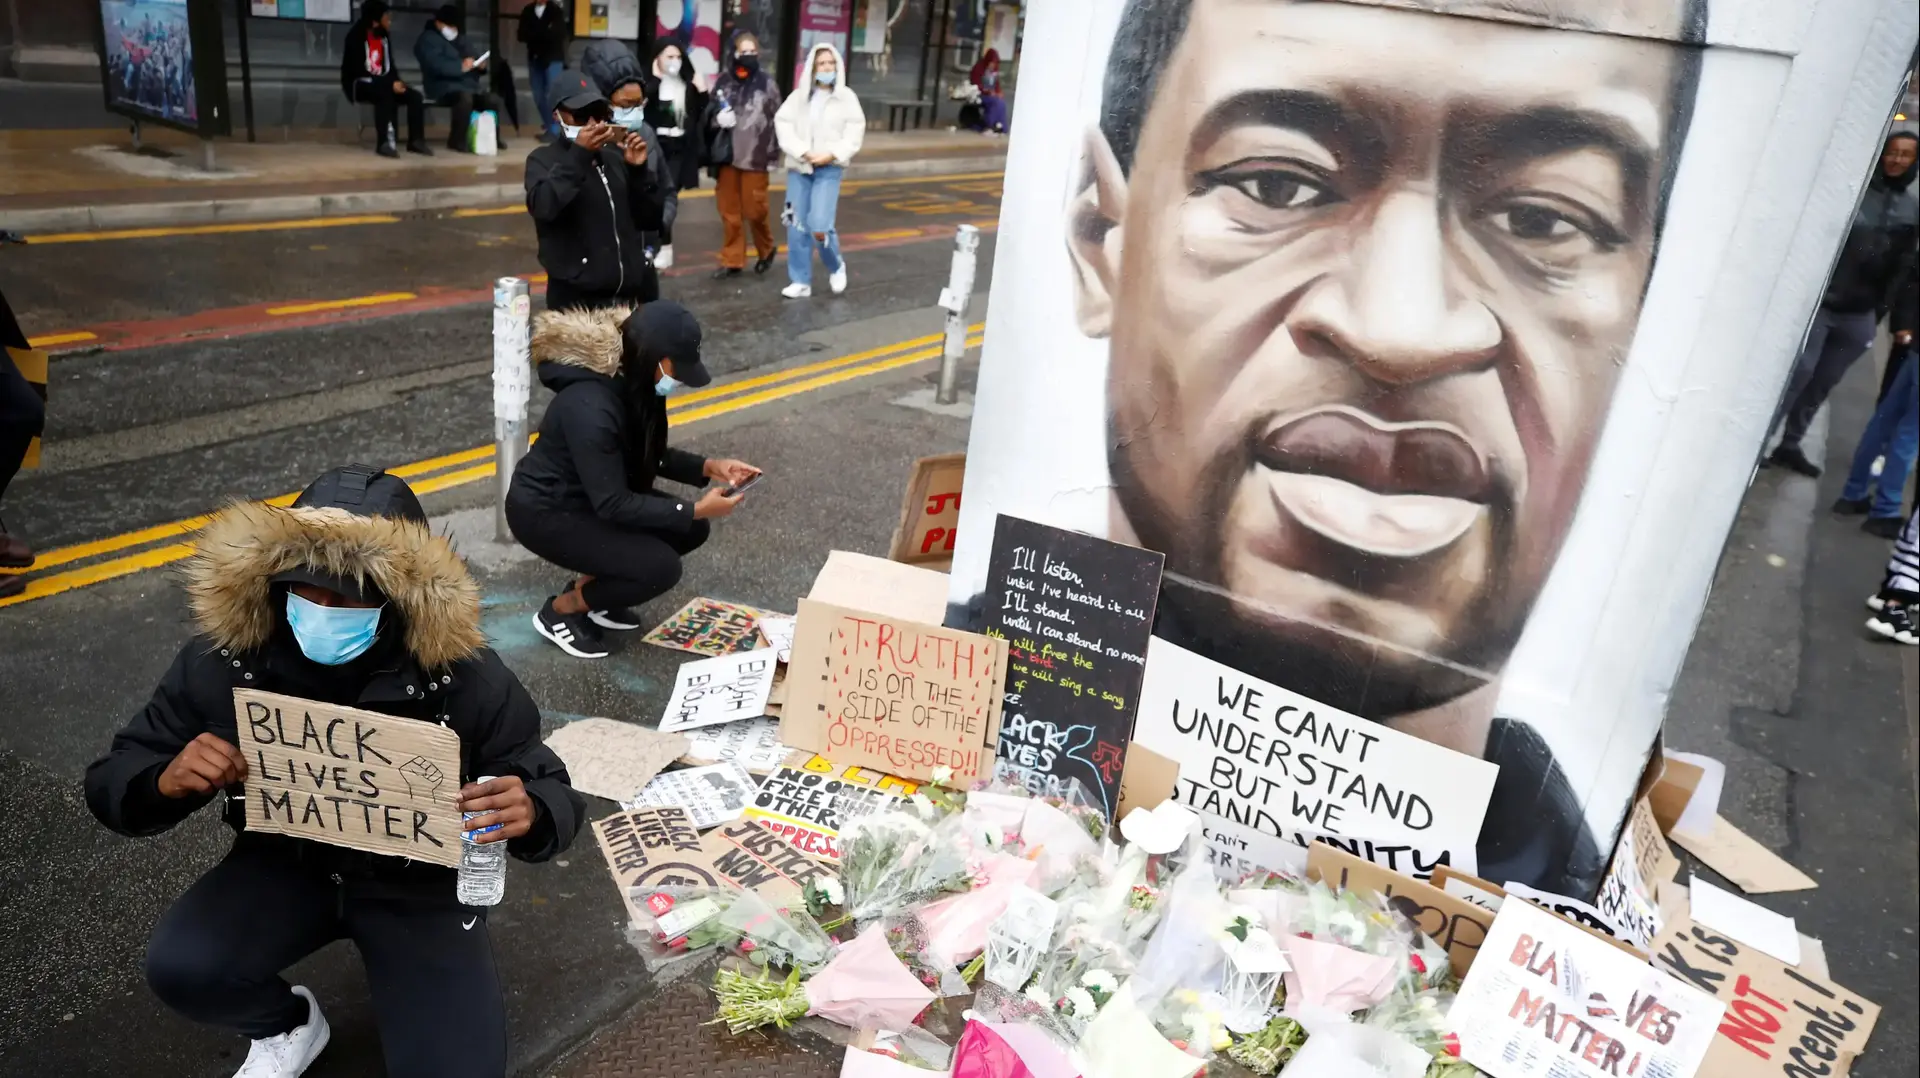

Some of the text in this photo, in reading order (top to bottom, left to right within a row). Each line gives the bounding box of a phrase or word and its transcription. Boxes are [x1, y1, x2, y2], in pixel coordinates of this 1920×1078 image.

[1012, 546, 1036, 573] I'll
[1001, 590, 1029, 613] I'll
[1006, 575, 1146, 621] until I've heard it all
[844, 616, 974, 680] TRUTH
[1002, 615, 1145, 665] until I can stand no more
[1013, 637, 1037, 653] will
[1041, 643, 1069, 662] free
[1072, 651, 1094, 670] the
[858, 668, 878, 691] IS
[924, 681, 963, 706] THE
[1012, 663, 1124, 709] we will sing a song
[1014, 680, 1027, 693] of
[245, 701, 393, 766] BLACK
[843, 691, 977, 735] SIDE OF THE
[999, 711, 1066, 752] LACK
[1217, 676, 1380, 763] WE CAN'T
[828, 722, 978, 776] OPPRESSED!!
[996, 735, 1057, 771] IVES
[1172, 698, 1433, 830] UNDERSTAND
[257, 750, 380, 798] LIVES
[763, 779, 824, 804] FREE
[776, 768, 822, 787] NO
[1210, 756, 1346, 834] BUT WE
[260, 788, 443, 848] MATTER
[631, 811, 671, 849] LIVES
[656, 808, 702, 853] BLACK
[600, 814, 649, 875] MATTER
[724, 820, 829, 889] JUSTICE
[1509, 933, 1558, 986] BLA
[1717, 974, 1788, 1060] NOT
